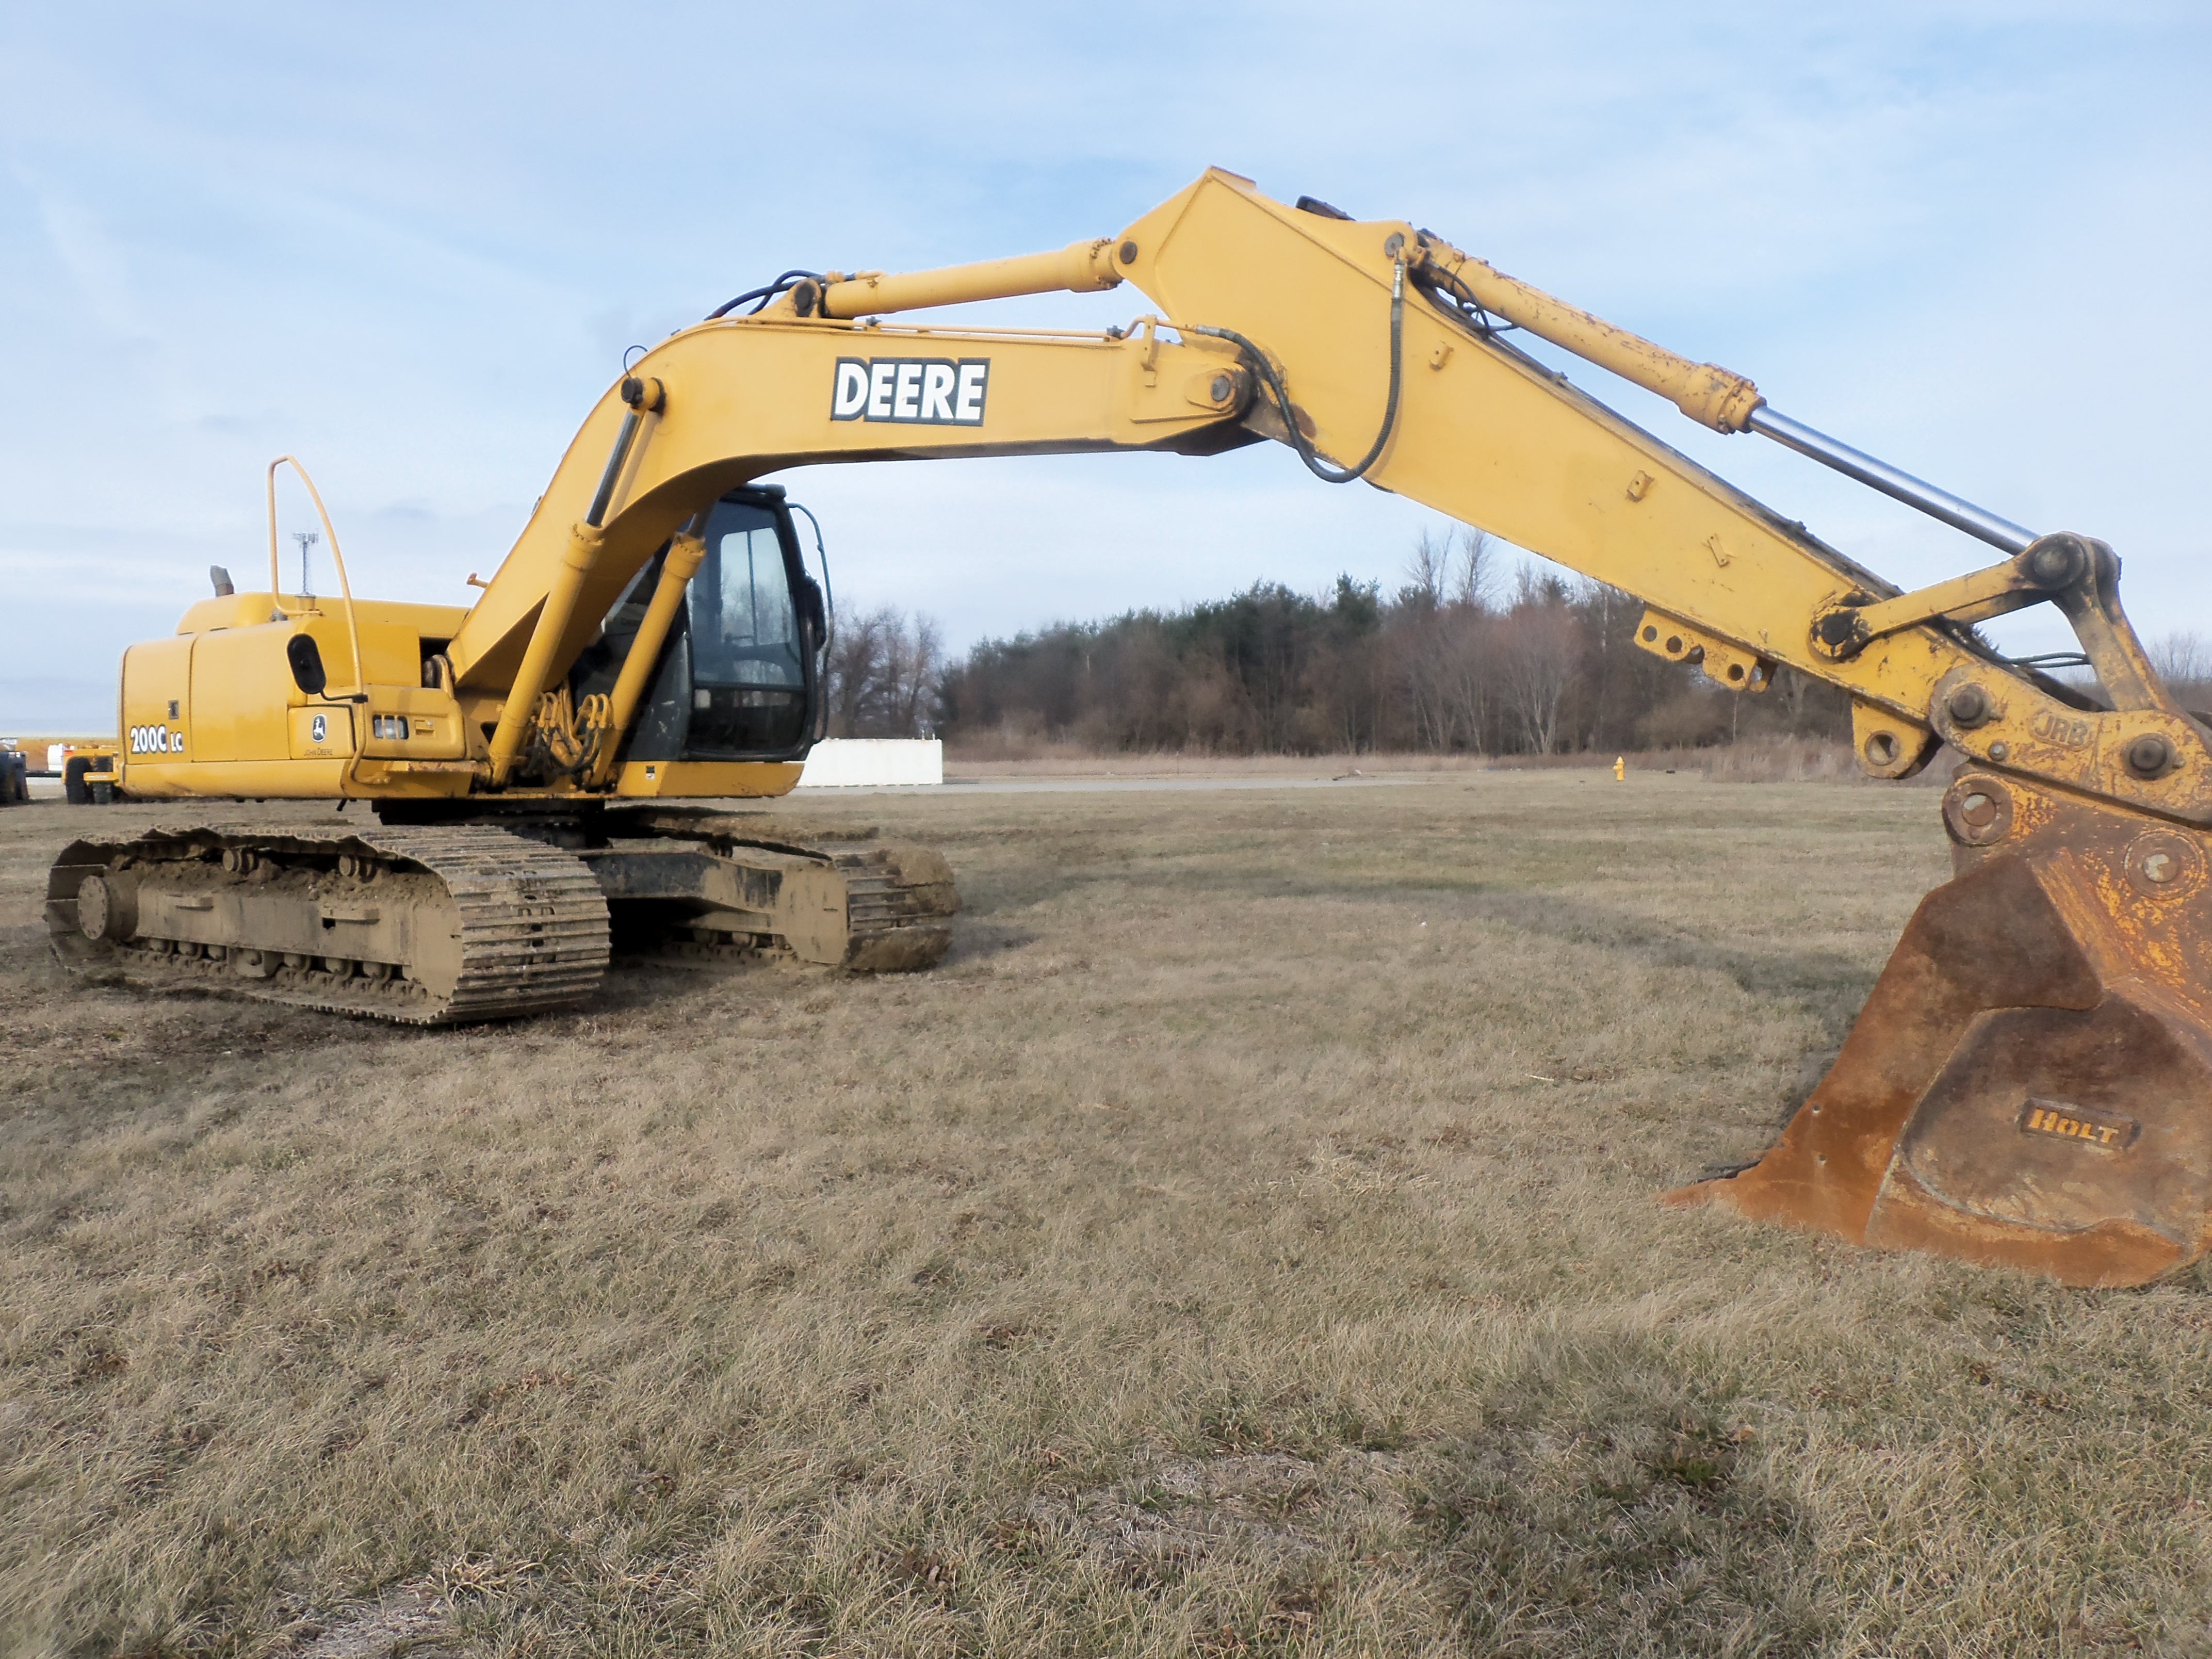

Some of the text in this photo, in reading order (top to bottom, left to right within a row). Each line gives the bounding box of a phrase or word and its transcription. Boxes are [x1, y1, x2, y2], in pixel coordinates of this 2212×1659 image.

[834, 362, 986, 420] DEERE
[130, 725, 183, 753] 200C LC
[2035, 715, 2088, 746] JRB
[2028, 1109, 2120, 1143] HOLT
